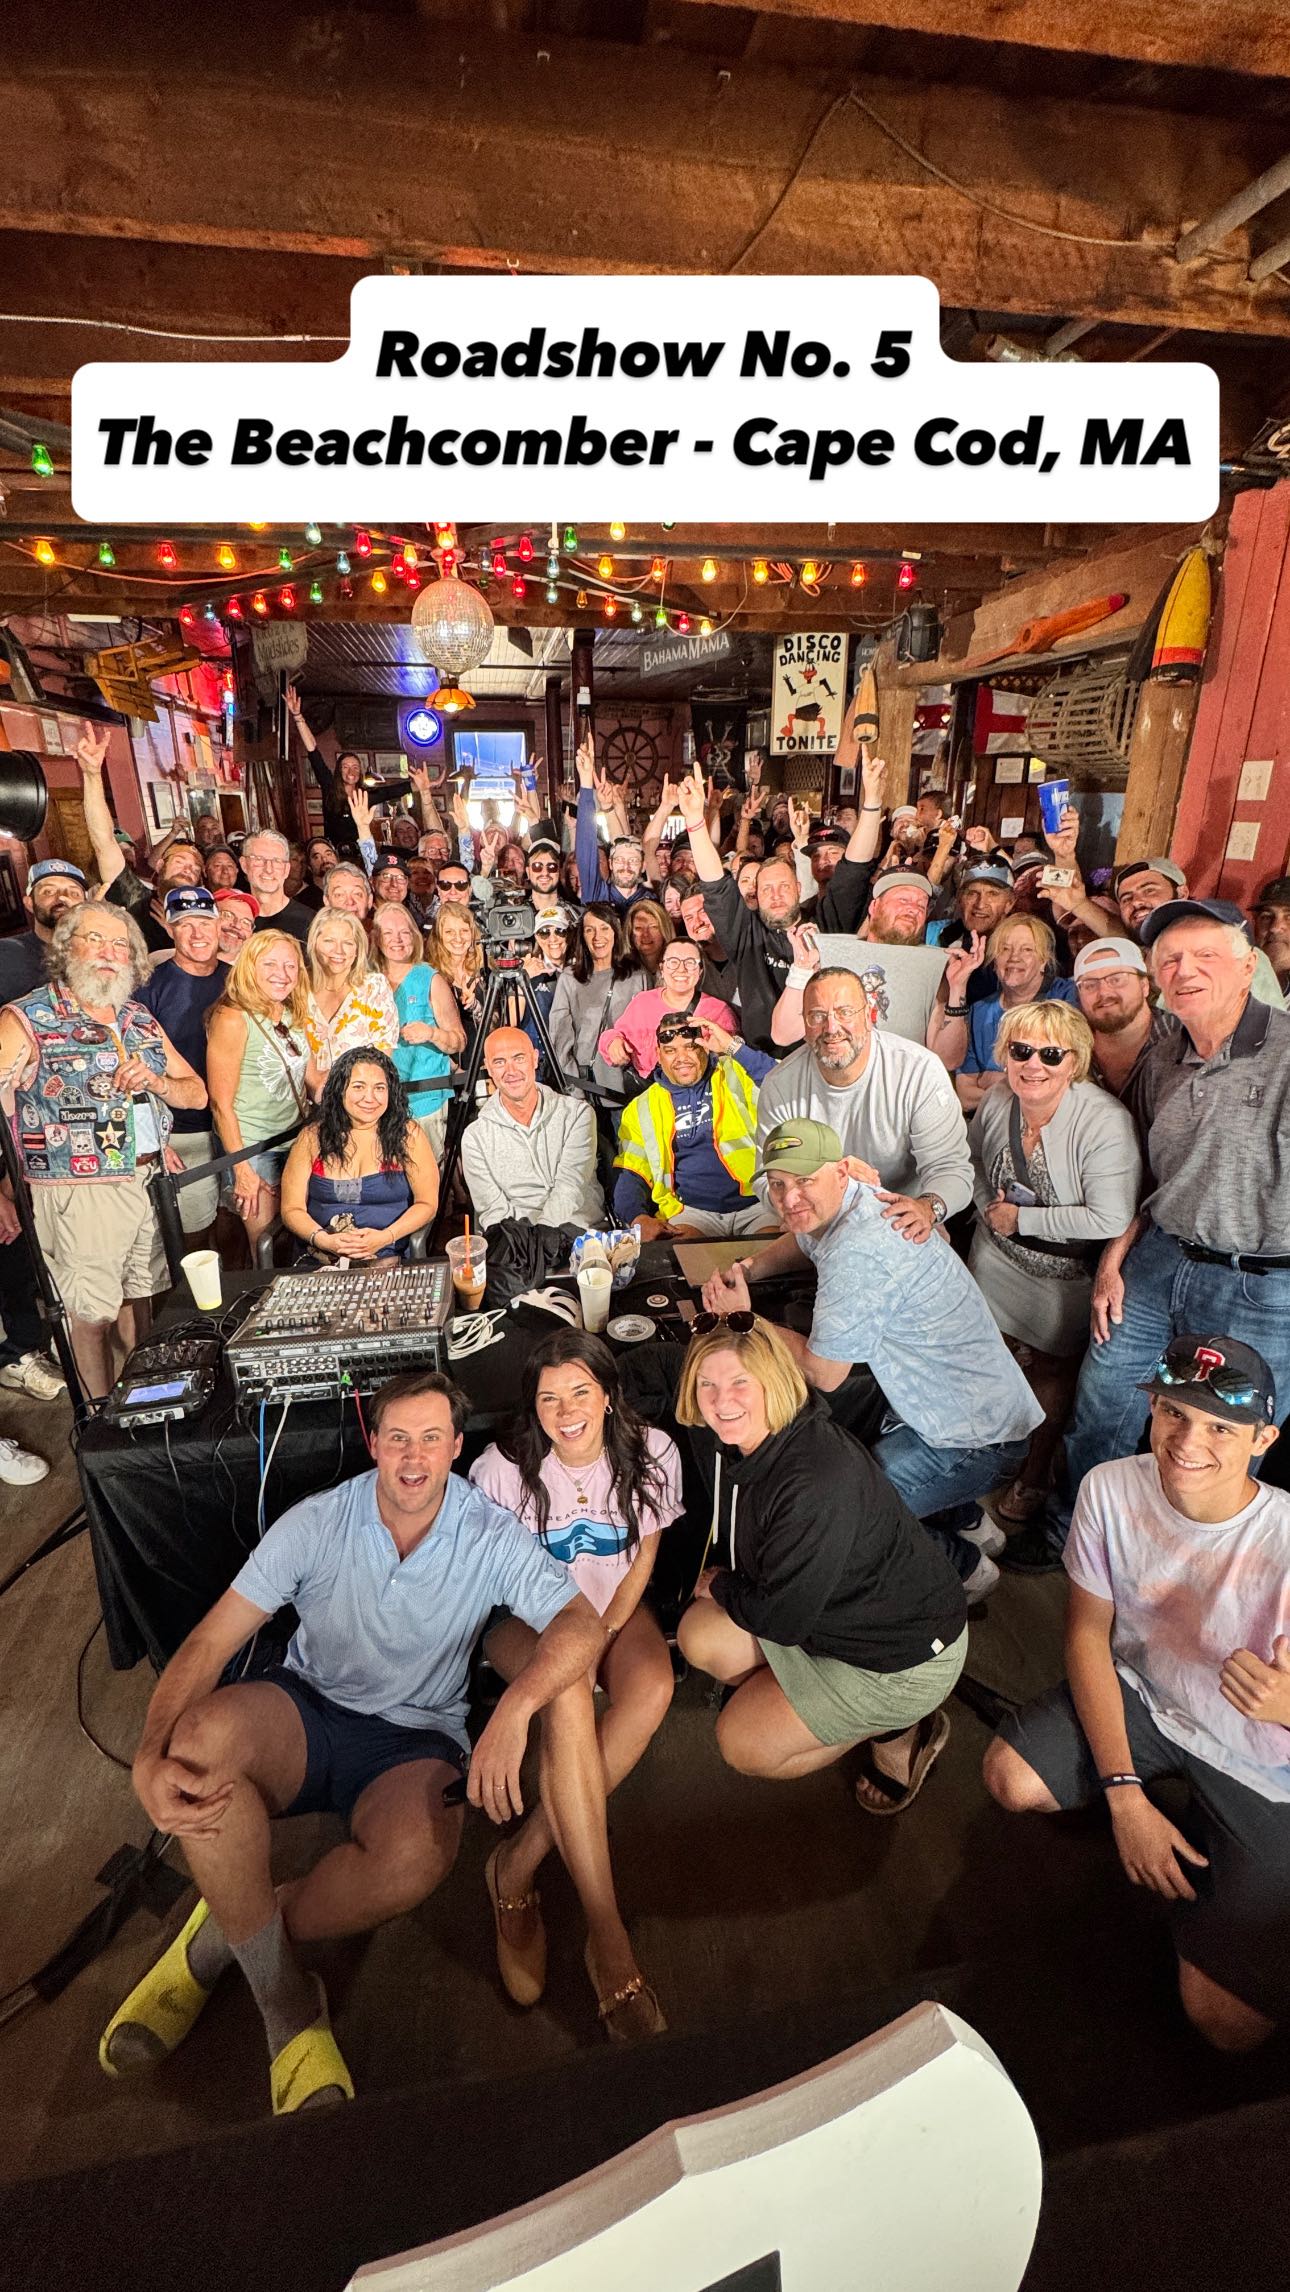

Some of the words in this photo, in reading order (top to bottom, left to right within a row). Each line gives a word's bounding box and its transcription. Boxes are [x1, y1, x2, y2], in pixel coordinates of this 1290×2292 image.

[783, 634, 842, 653] DISCO
[779, 650, 841, 666] DANCING
[776, 735, 837, 750] TONITE
